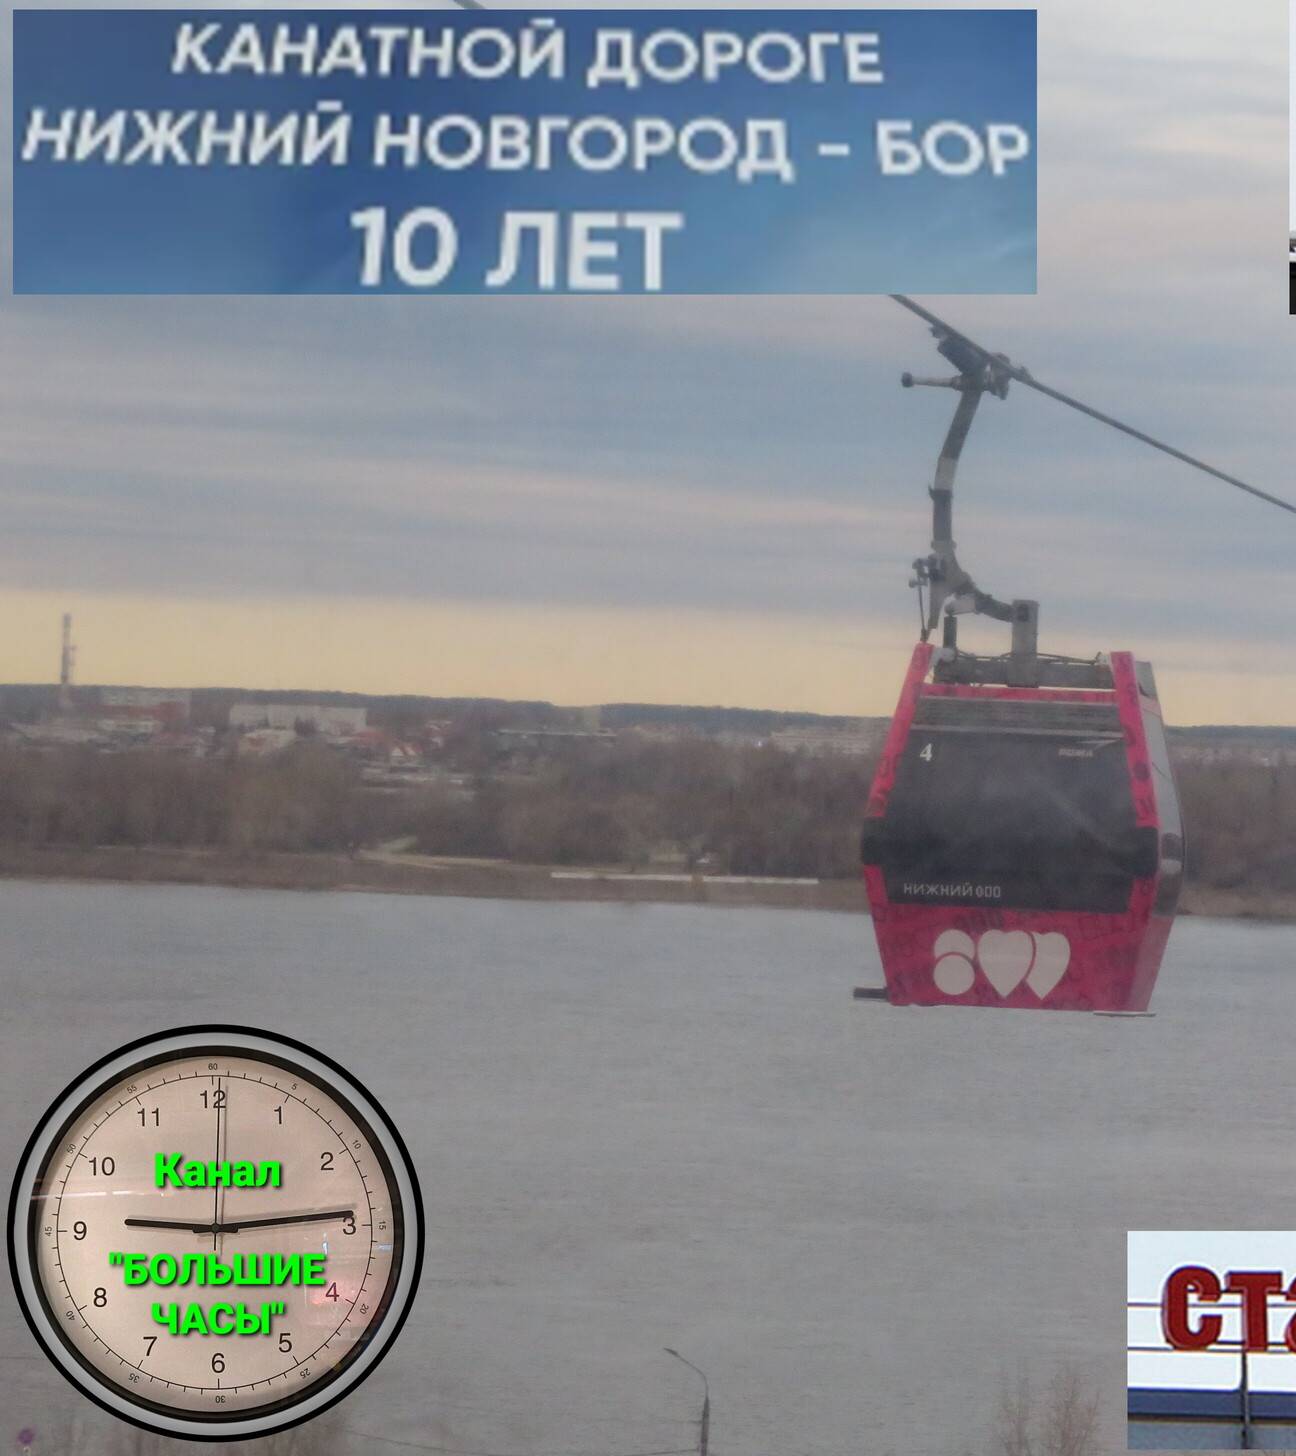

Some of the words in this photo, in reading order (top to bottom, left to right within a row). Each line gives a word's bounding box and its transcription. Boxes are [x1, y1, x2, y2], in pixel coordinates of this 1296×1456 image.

[172, 18, 565, 80] КАНАТНОЙ
[585, 29, 884, 89] ДОРОГЕ
[22, 100, 351, 166] НИЖНИЙ
[373, 113, 795, 183] НОВГОРОД
[876, 120, 1030, 178] БОР
[350, 206, 457, 287] 10
[485, 210, 684, 291] ЛЕТ
[919, 743, 933, 762] 4
[903, 881, 973, 897] НИЖНИЙ
[207, 1062, 219, 1071] 60
[291, 1082, 299, 1091] 5
[199, 1089, 227, 1109] 12
[137, 1107, 161, 1127] 11
[273, 1105, 283, 1125] 1
[89, 1156, 116, 1176] 10
[319, 1151, 335, 1171] 2
[72, 1220, 88, 1241] 9
[342, 1211, 357, 1236] 3
[92, 1286, 108, 1308] 8
[325, 1281, 341, 1303] 4
[142, 1335, 158, 1357] 7
[278, 1333, 293, 1354] 5
[211, 1352, 226, 1374] 6
[214, 1395, 226, 1404] 30
